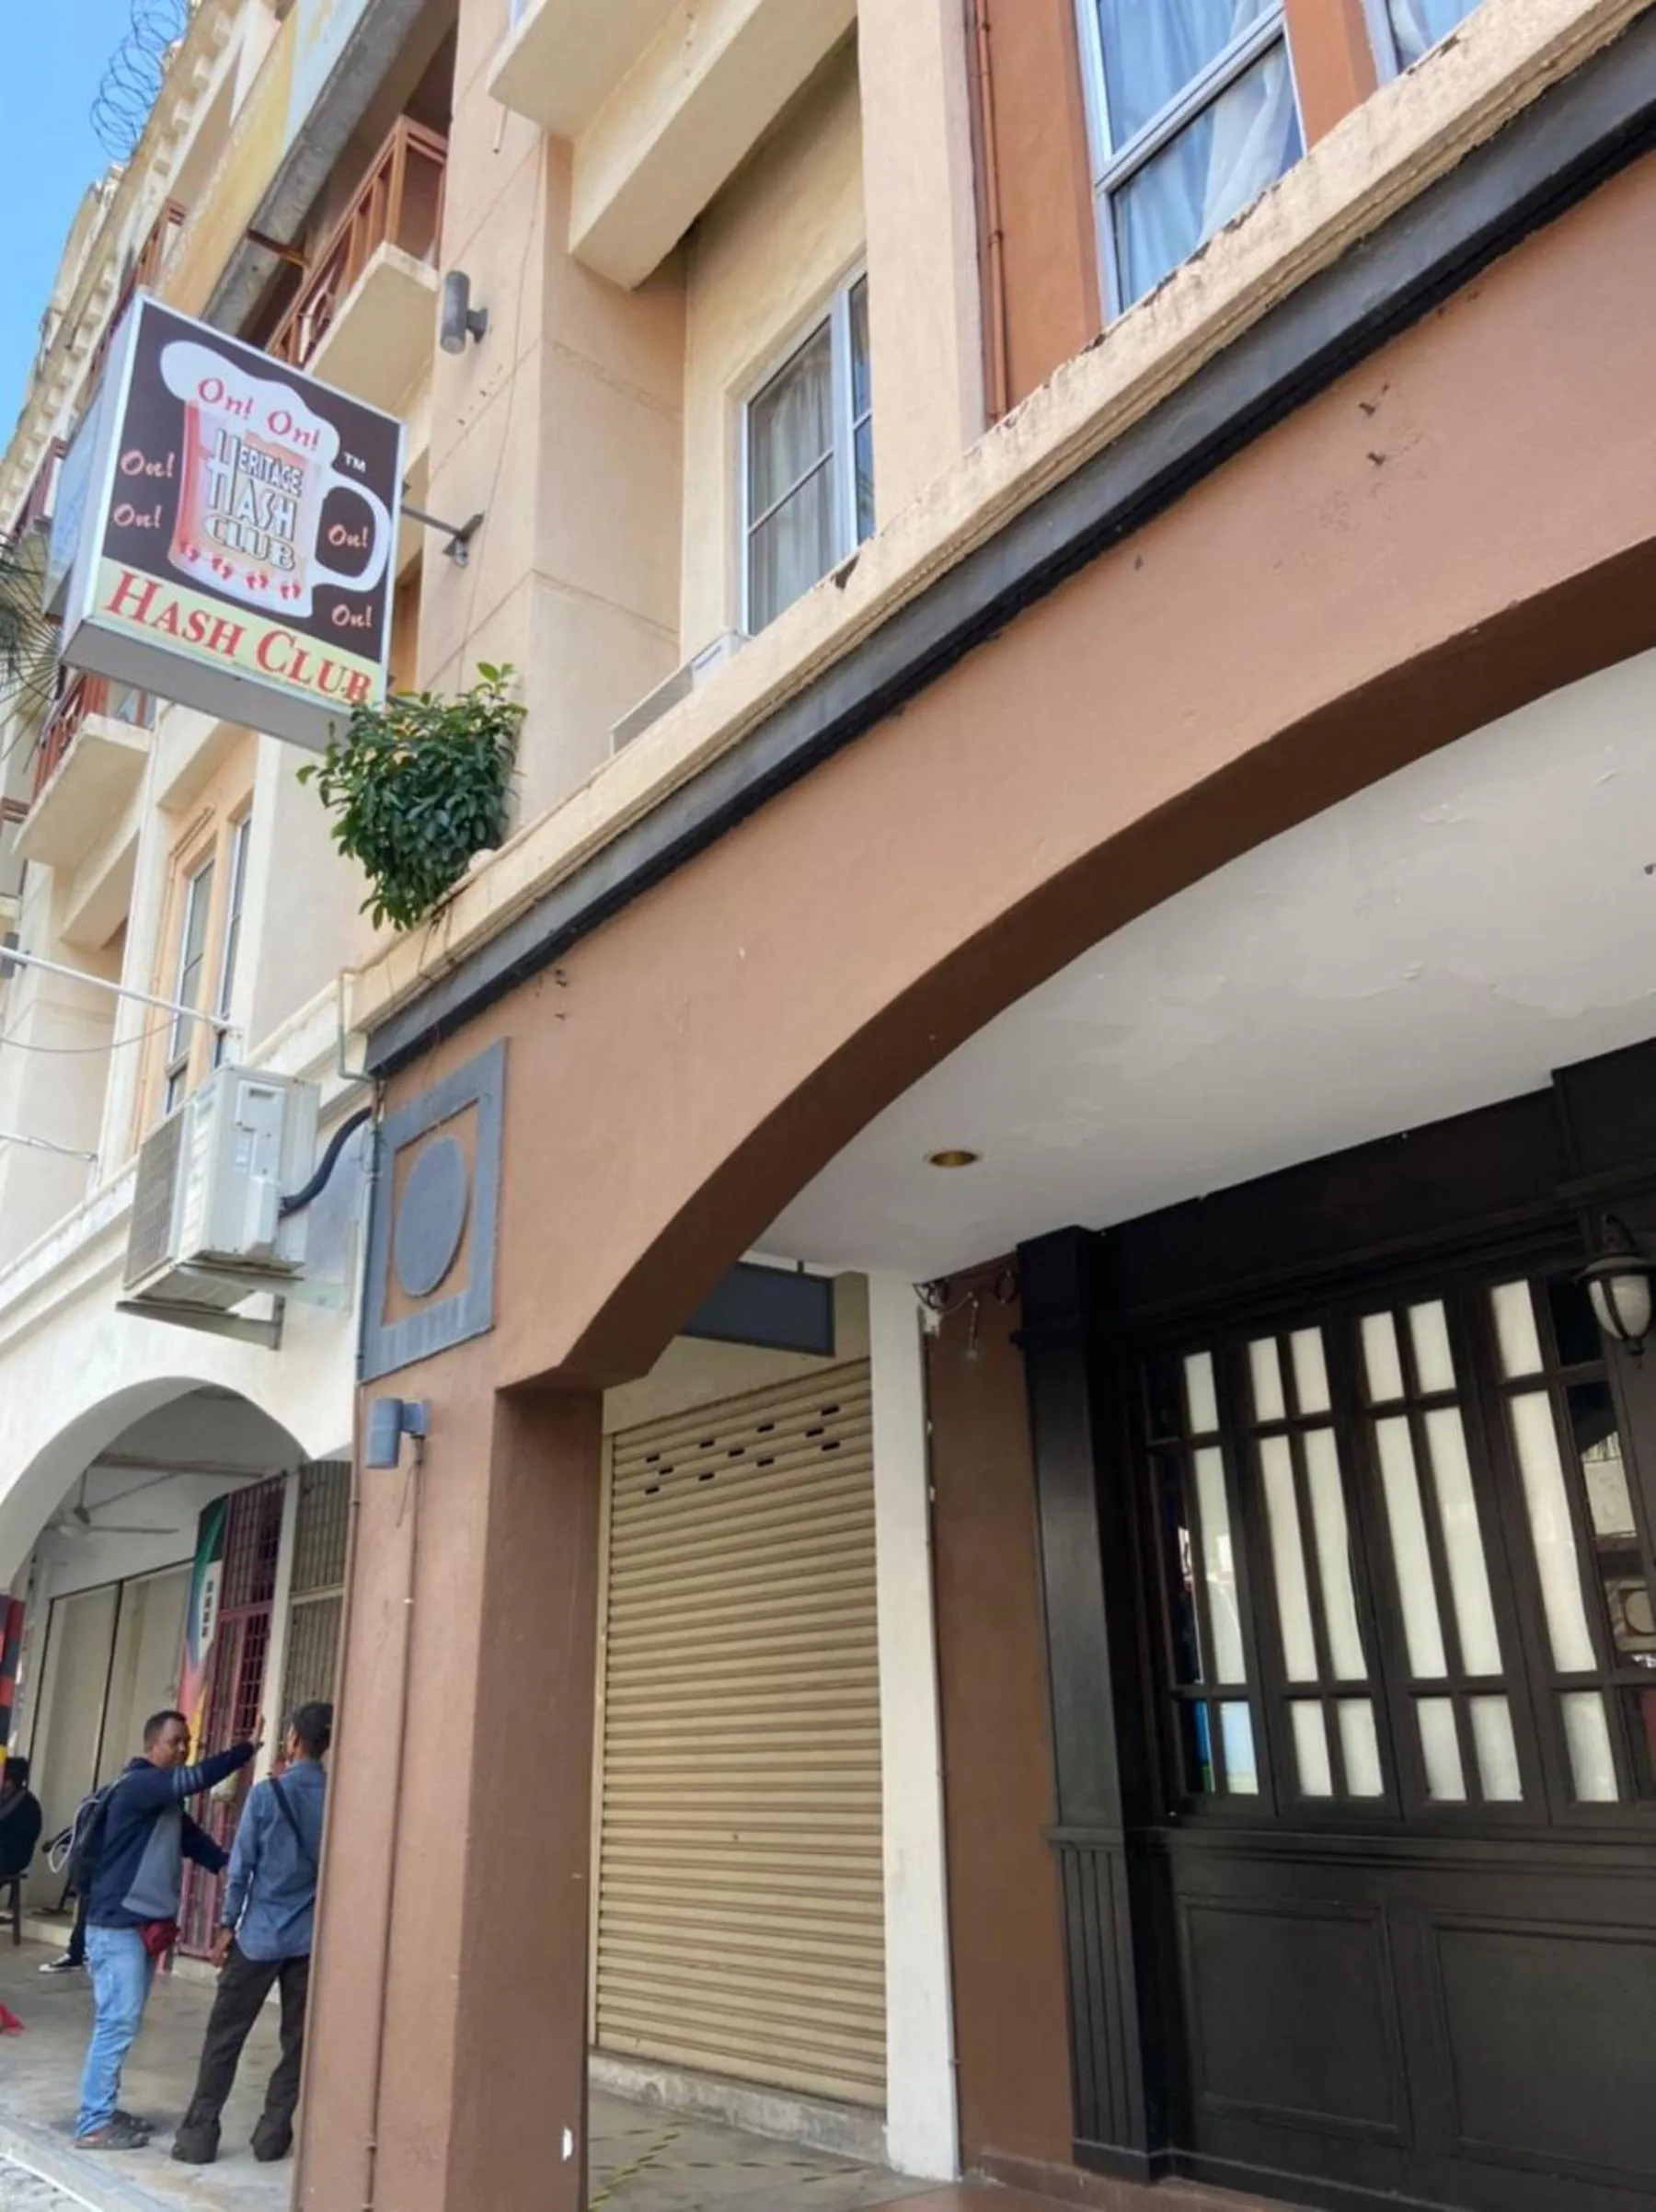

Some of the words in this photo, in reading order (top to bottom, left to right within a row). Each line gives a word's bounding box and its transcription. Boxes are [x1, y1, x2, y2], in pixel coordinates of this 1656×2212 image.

[198, 378, 253, 420] On!
[266, 410, 320, 451] On!
[121, 450, 176, 478] On!
[213, 429, 303, 498] HERITAGE
[113, 503, 162, 529] On!
[328, 524, 368, 548] On!
[204, 513, 295, 571] CLUB
[105, 570, 247, 657] HASH
[256, 628, 372, 704] CLUB
[331, 604, 373, 628] On!
